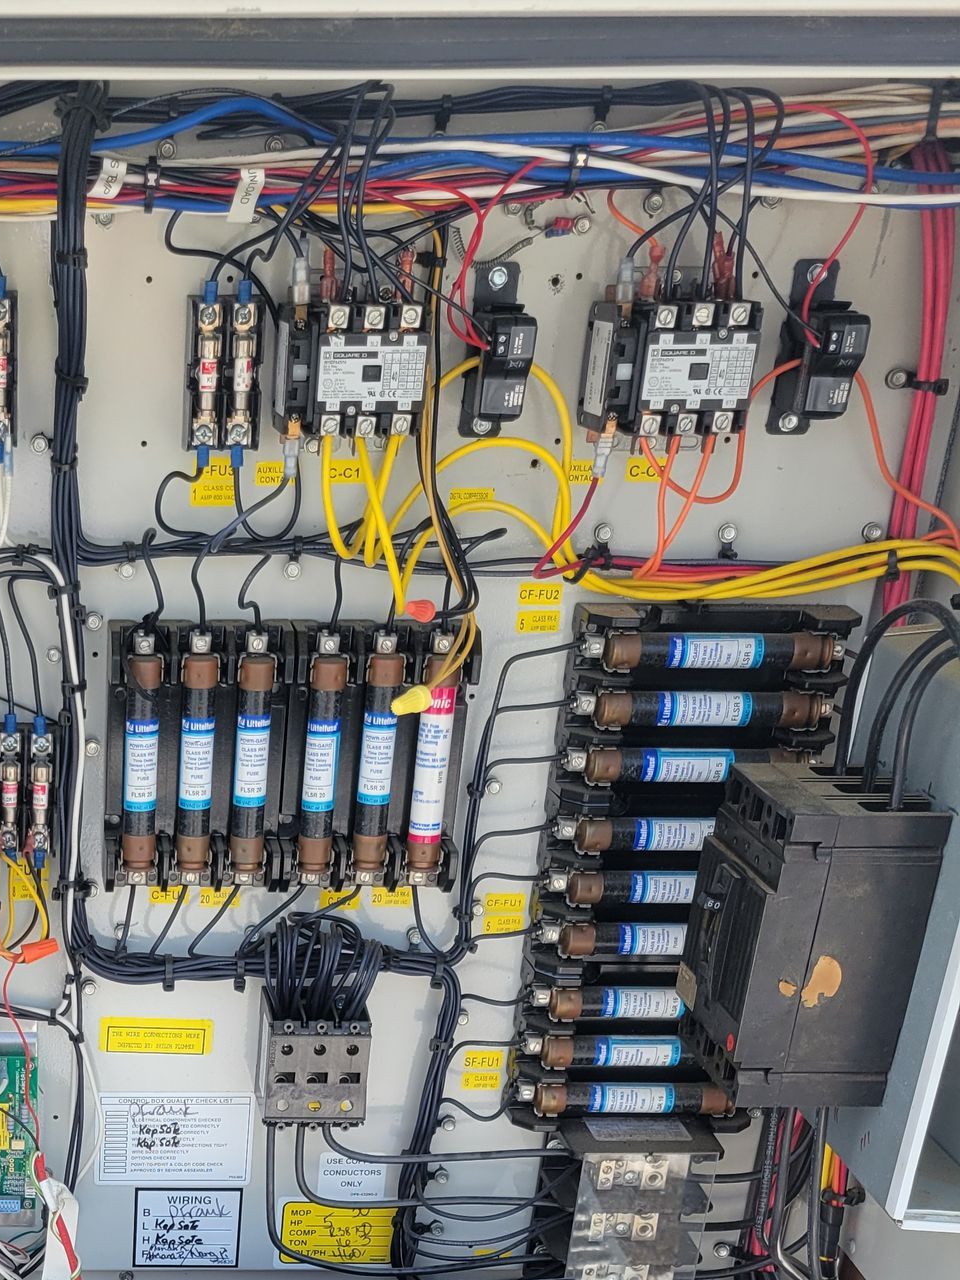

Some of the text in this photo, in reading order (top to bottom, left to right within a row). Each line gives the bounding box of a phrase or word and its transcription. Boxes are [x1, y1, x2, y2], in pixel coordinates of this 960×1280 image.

[240, 168, 256, 205] UNLOAD
[329, 468, 360, 479] C-C1
[520, 589, 559, 600] CF-FU2
[731, 703, 740, 722] FLSR
[131, 791, 146, 799] FLSR
[185, 789, 200, 797] FLSR
[151, 890, 181, 900] C-FU
[201, 894, 210, 904] 20
[372, 894, 382, 904] 20
[487, 899, 522, 908] CF-FU1
[707, 900, 721, 910] 60
[464, 1057, 500, 1067] SF-FU1
[167, 1195, 212, 1205] WIRING
[143, 1208, 151, 1217] B
[142, 1222, 149, 1230] L
[290, 1219, 303, 1227] HP
[142, 1236, 150, 1244] H
[289, 1239, 308, 1247] TON
[295, 1249, 327, 1257] OLT/PH
